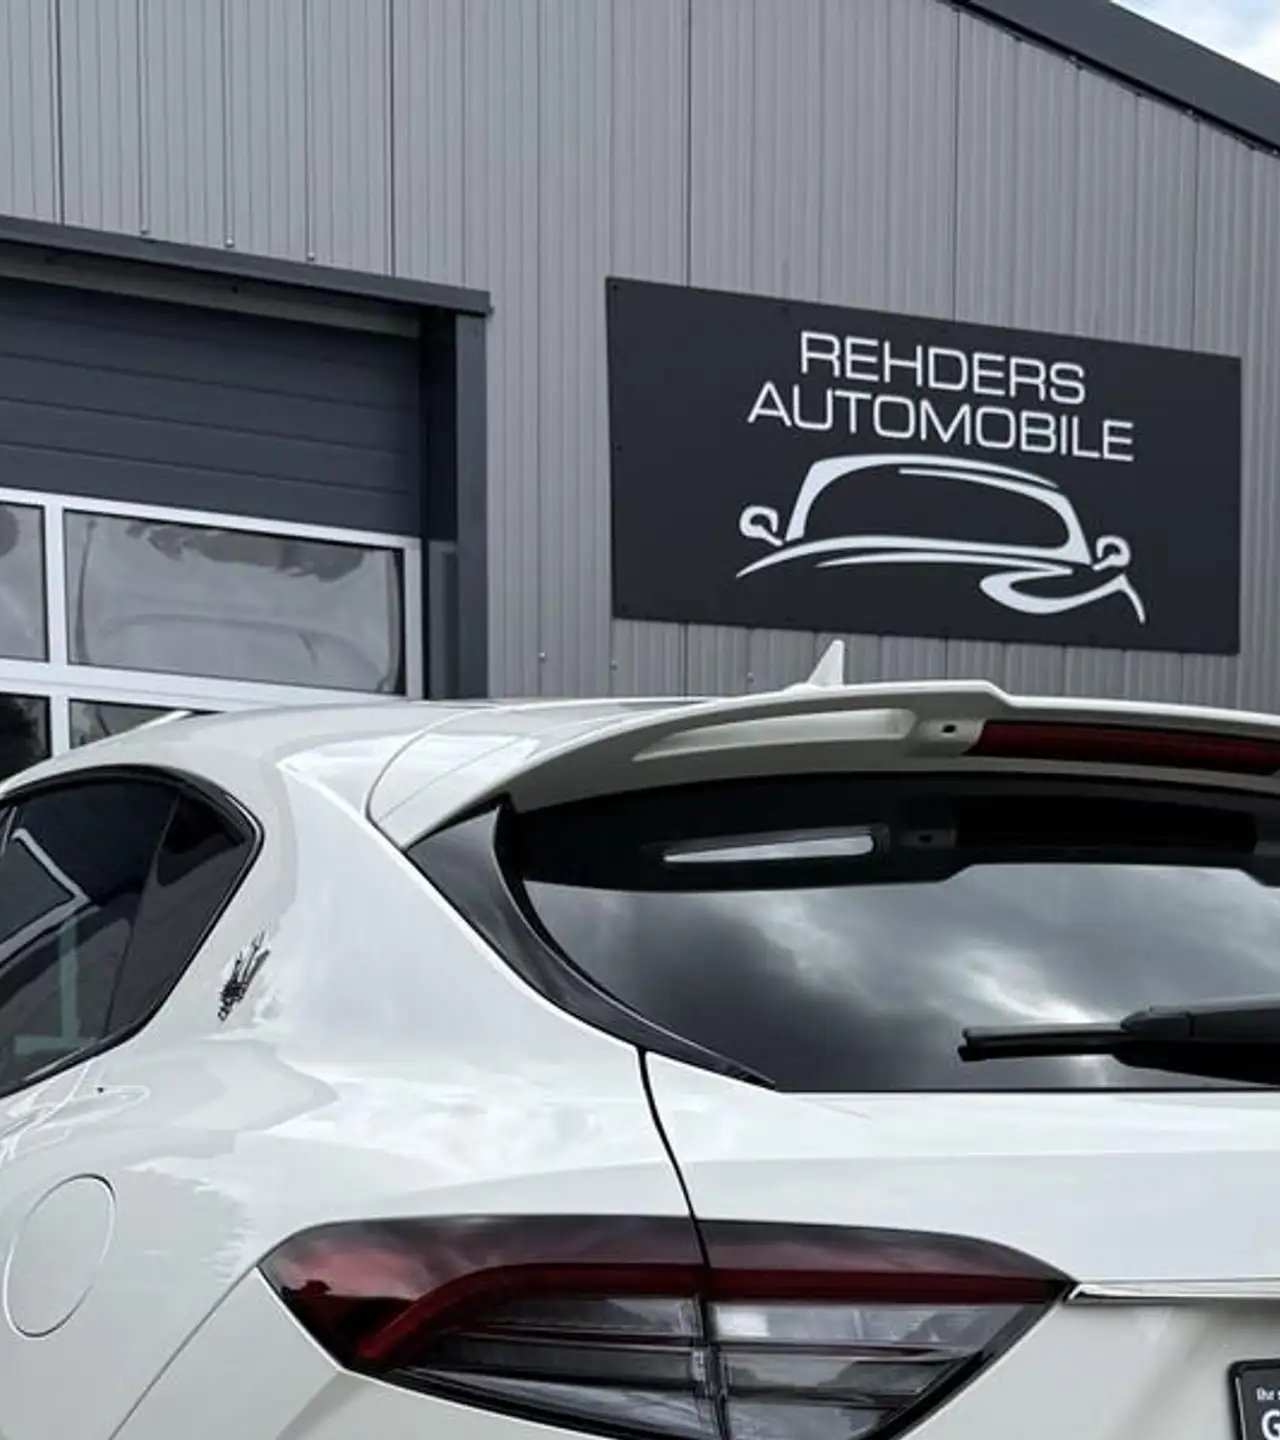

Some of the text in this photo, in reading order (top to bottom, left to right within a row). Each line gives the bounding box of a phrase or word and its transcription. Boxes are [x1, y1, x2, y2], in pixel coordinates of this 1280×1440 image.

[800, 330, 1086, 404] REHDERS
[747, 381, 1135, 462] AUTOMOBILE
[1256, 1387, 1274, 1401] Ihr
